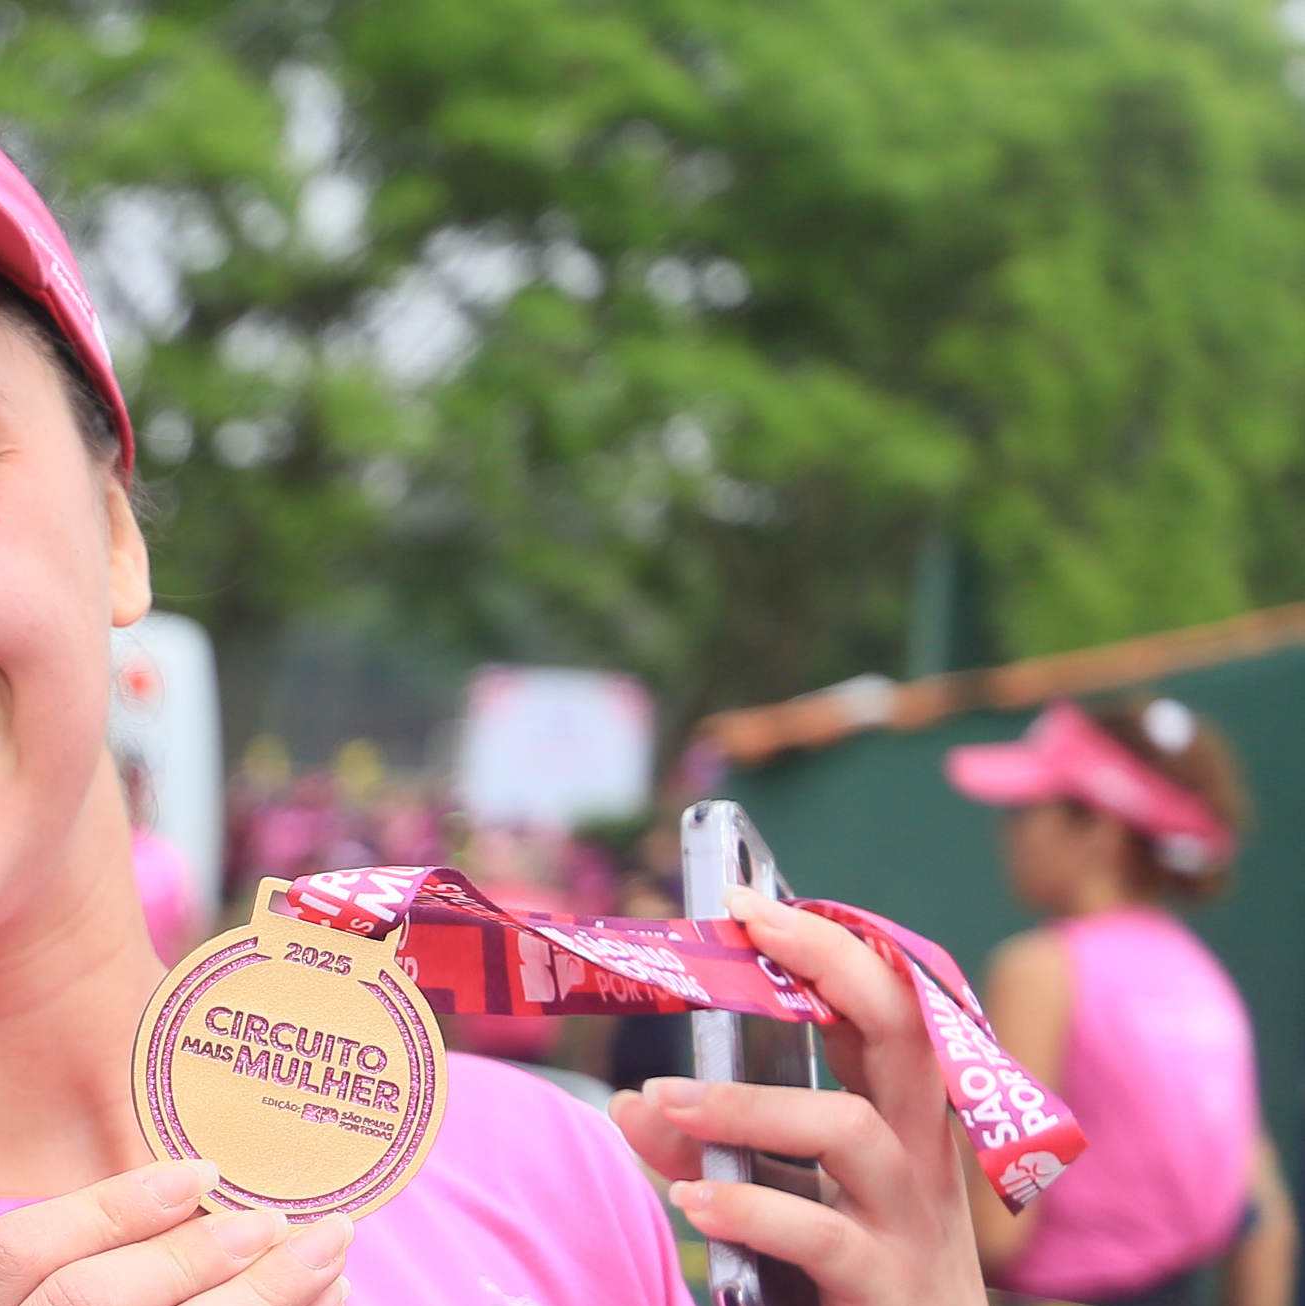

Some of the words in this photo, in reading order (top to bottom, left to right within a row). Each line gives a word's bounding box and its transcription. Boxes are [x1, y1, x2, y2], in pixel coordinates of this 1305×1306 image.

[283, 941, 354, 977] 2025
[180, 1035, 234, 1064] MAIS
[232, 1044, 401, 1115] MULHER
[204, 1006, 389, 1076] CIRCUITO
[261, 1095, 302, 1114] EDIÇÃO:
[959, 1065, 1020, 1149] SÃO
[997, 1068, 1060, 1138] POR
